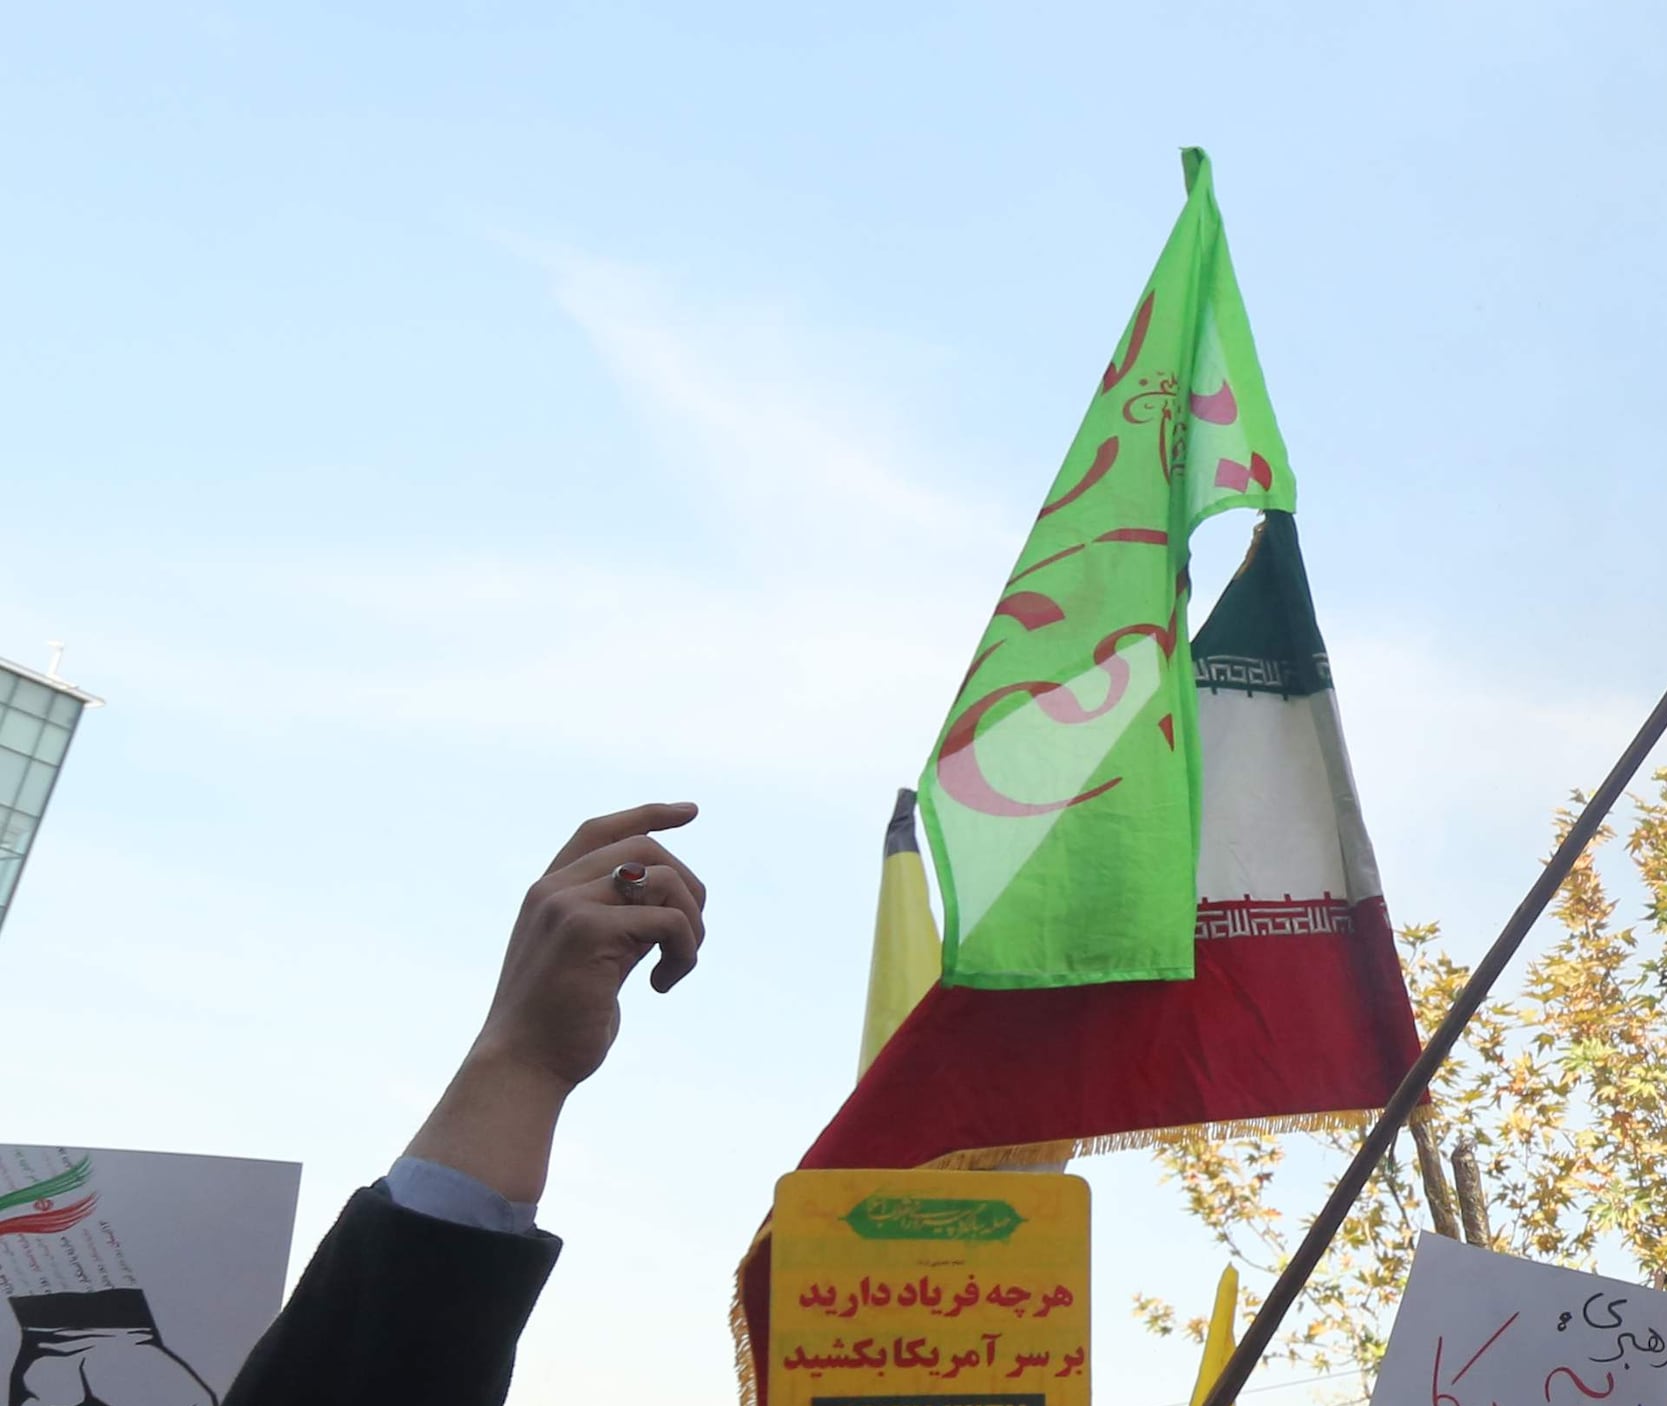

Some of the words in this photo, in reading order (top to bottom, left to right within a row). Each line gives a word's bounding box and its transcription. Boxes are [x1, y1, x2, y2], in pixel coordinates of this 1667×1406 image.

[798, 1275, 892, 1318] دارید
[896, 1274, 980, 1318] فریاد
[783, 1336, 888, 1378] بکشید
[892, 1332, 1003, 1378] آمریکا
[1004, 1349, 1050, 1378] سر
[1053, 1345, 1085, 1378] بر
